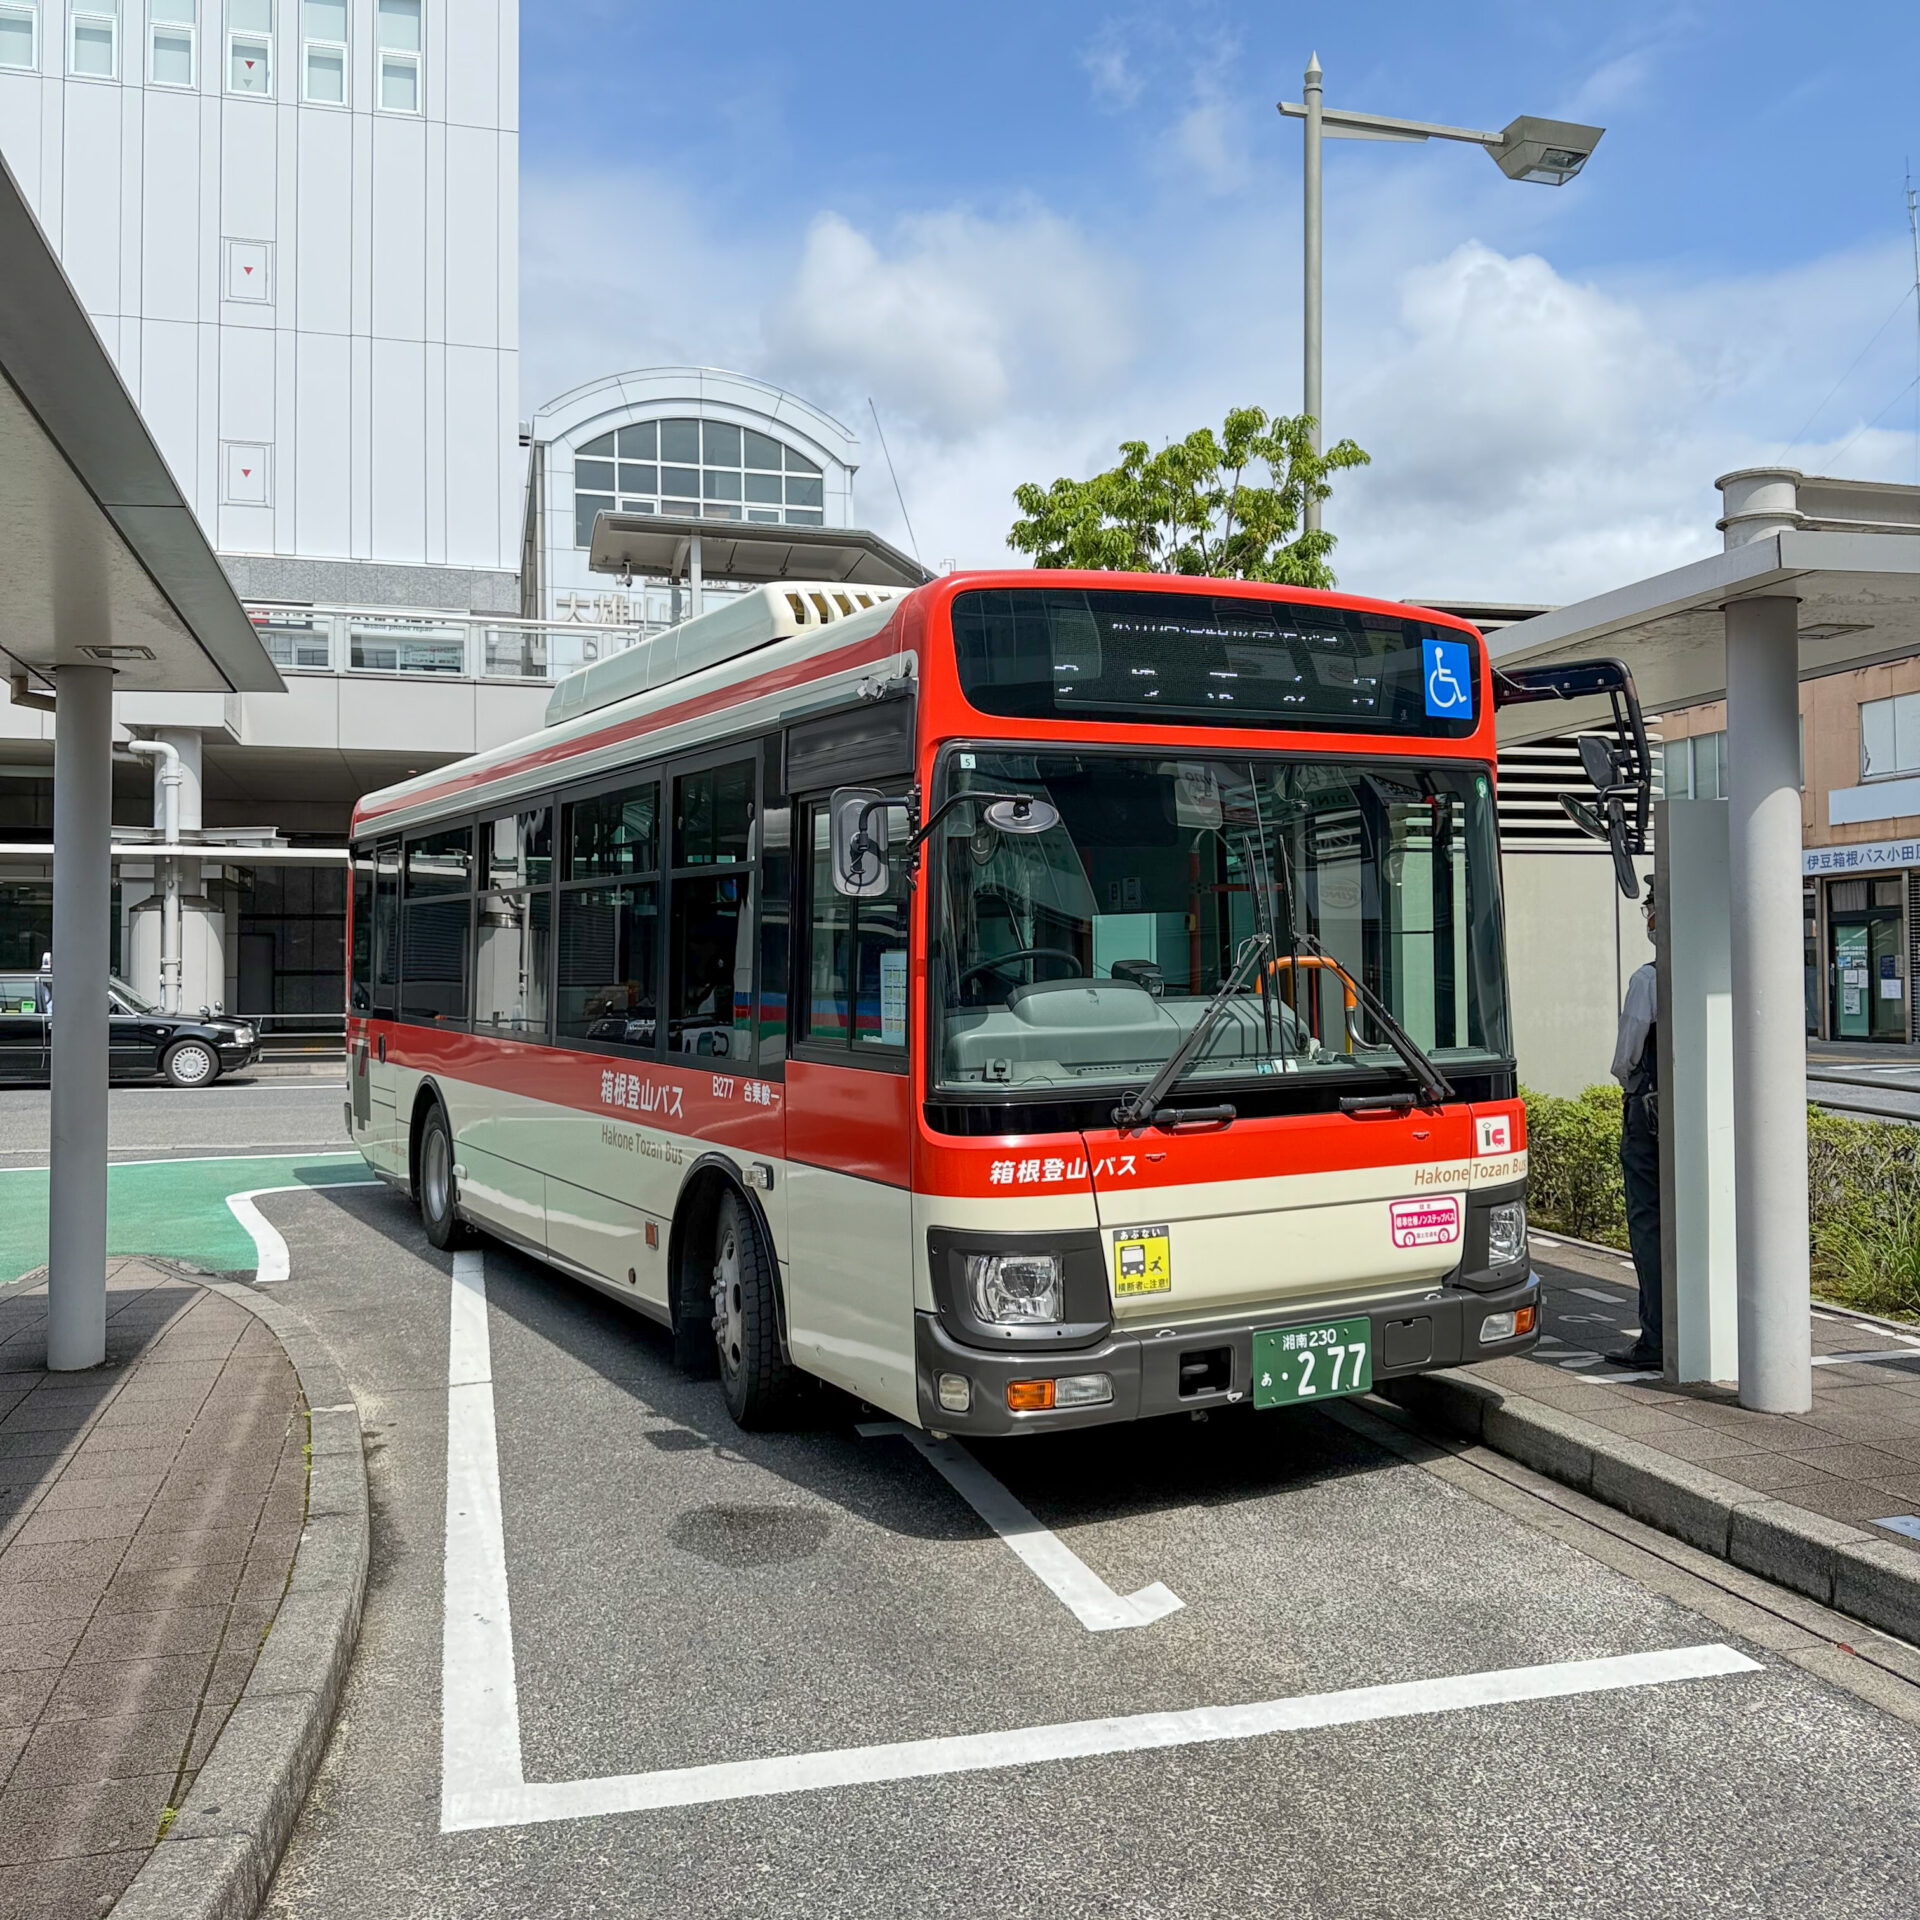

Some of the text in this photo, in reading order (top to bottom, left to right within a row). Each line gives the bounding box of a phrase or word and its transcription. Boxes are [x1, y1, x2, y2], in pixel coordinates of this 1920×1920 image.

[601, 1069, 683, 1119] 箱根登山バス
[712, 1075, 734, 1099] B277
[601, 1125, 683, 1165] Hakone Tozan Bus
[989, 1155, 1136, 1185] 箱根登山バス
[1414, 1158, 1526, 1186] Hakone Tozan Bus
[1120, 1227, 1160, 1240] あぶない
[1282, 1328, 1337, 1351] 湘南 230
[1261, 1371, 1272, 1387] あ
